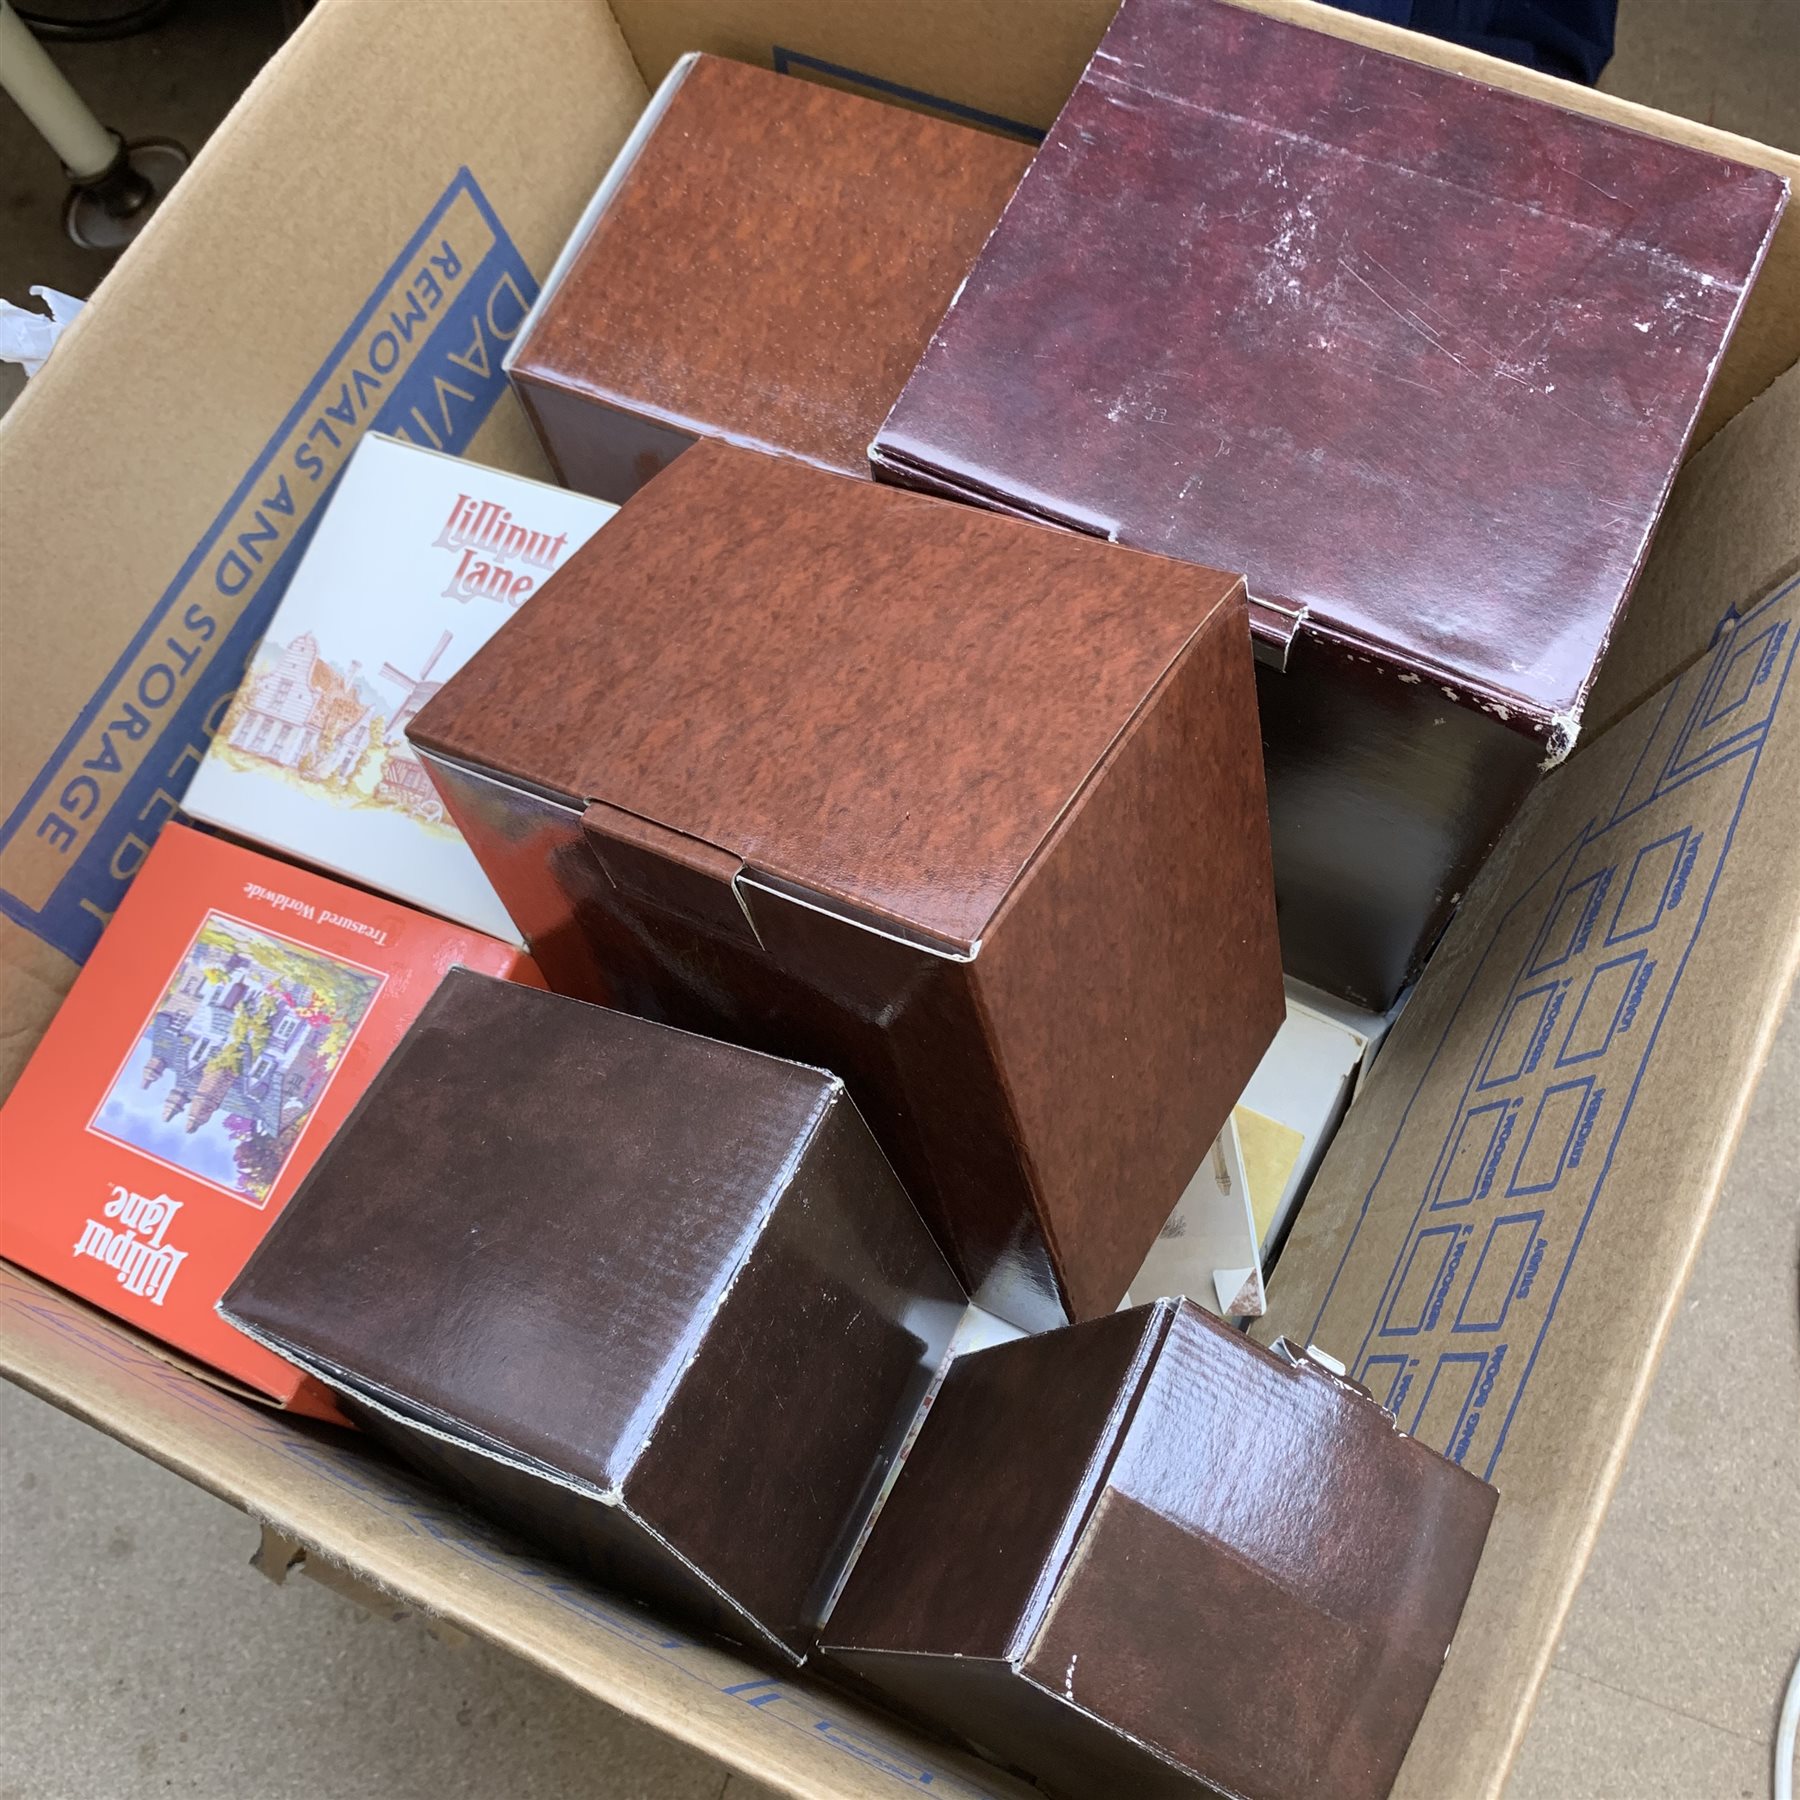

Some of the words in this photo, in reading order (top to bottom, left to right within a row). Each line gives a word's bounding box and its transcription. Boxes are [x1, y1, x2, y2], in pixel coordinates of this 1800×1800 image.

[295, 240, 462, 481] REMOVALS
[216, 474, 295, 596] AND
[431, 493, 568, 572] Lilliput
[440, 549, 534, 608] Lane
[36, 604, 216, 854] STORAGE
[243, 882, 315, 920] Worldwide
[317, 910, 388, 947] Treasured
[1525, 992, 1567, 1074] BEDROOM
[1476, 1112, 1518, 1199] BEDROOM
[1567, 1088, 1606, 1168] KITCHEN
[104, 1186, 184, 1249] Lane
[73, 1218, 189, 1306] Lilliput
[1424, 1241, 1467, 1331] BEDROOM
[1462, 1224, 1474, 1236] 2
[1516, 1238, 1548, 1299] STUDY
[1473, 1344, 1508, 1408] ROOM
